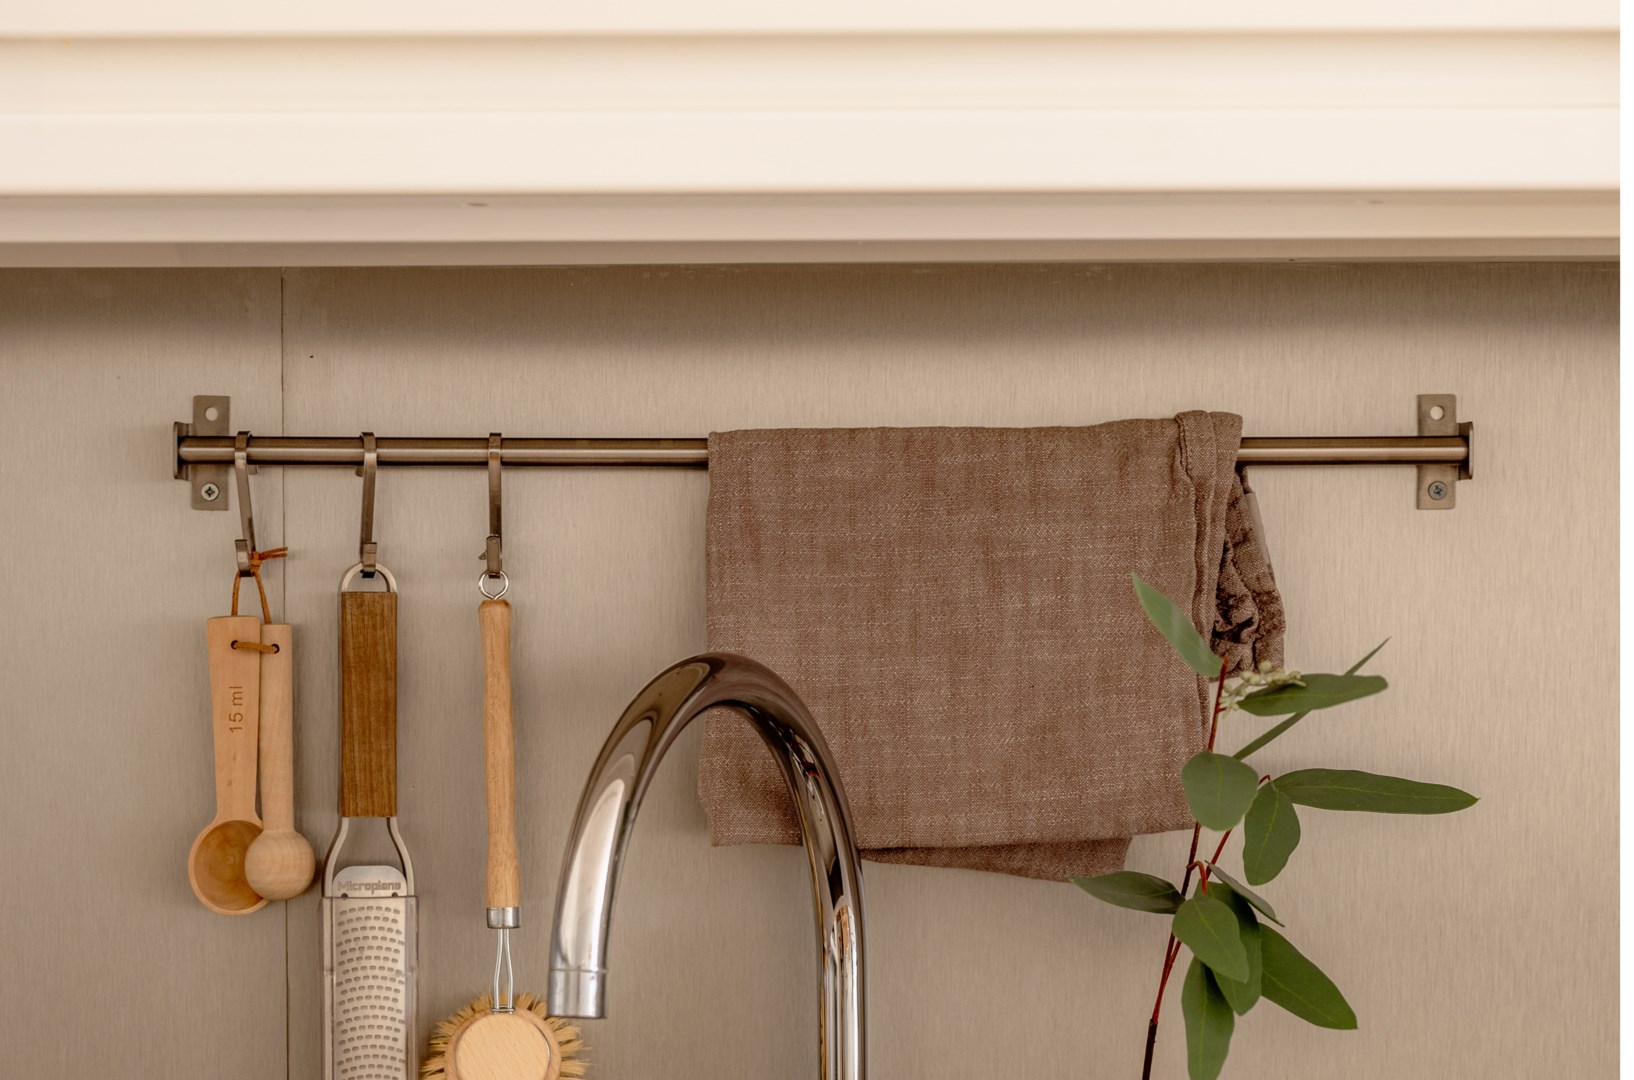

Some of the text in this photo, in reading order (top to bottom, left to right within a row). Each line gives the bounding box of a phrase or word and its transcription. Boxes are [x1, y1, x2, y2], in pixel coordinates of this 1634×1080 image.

[229, 686, 244, 733] 15 ml
[337, 880, 402, 896] Microplane
